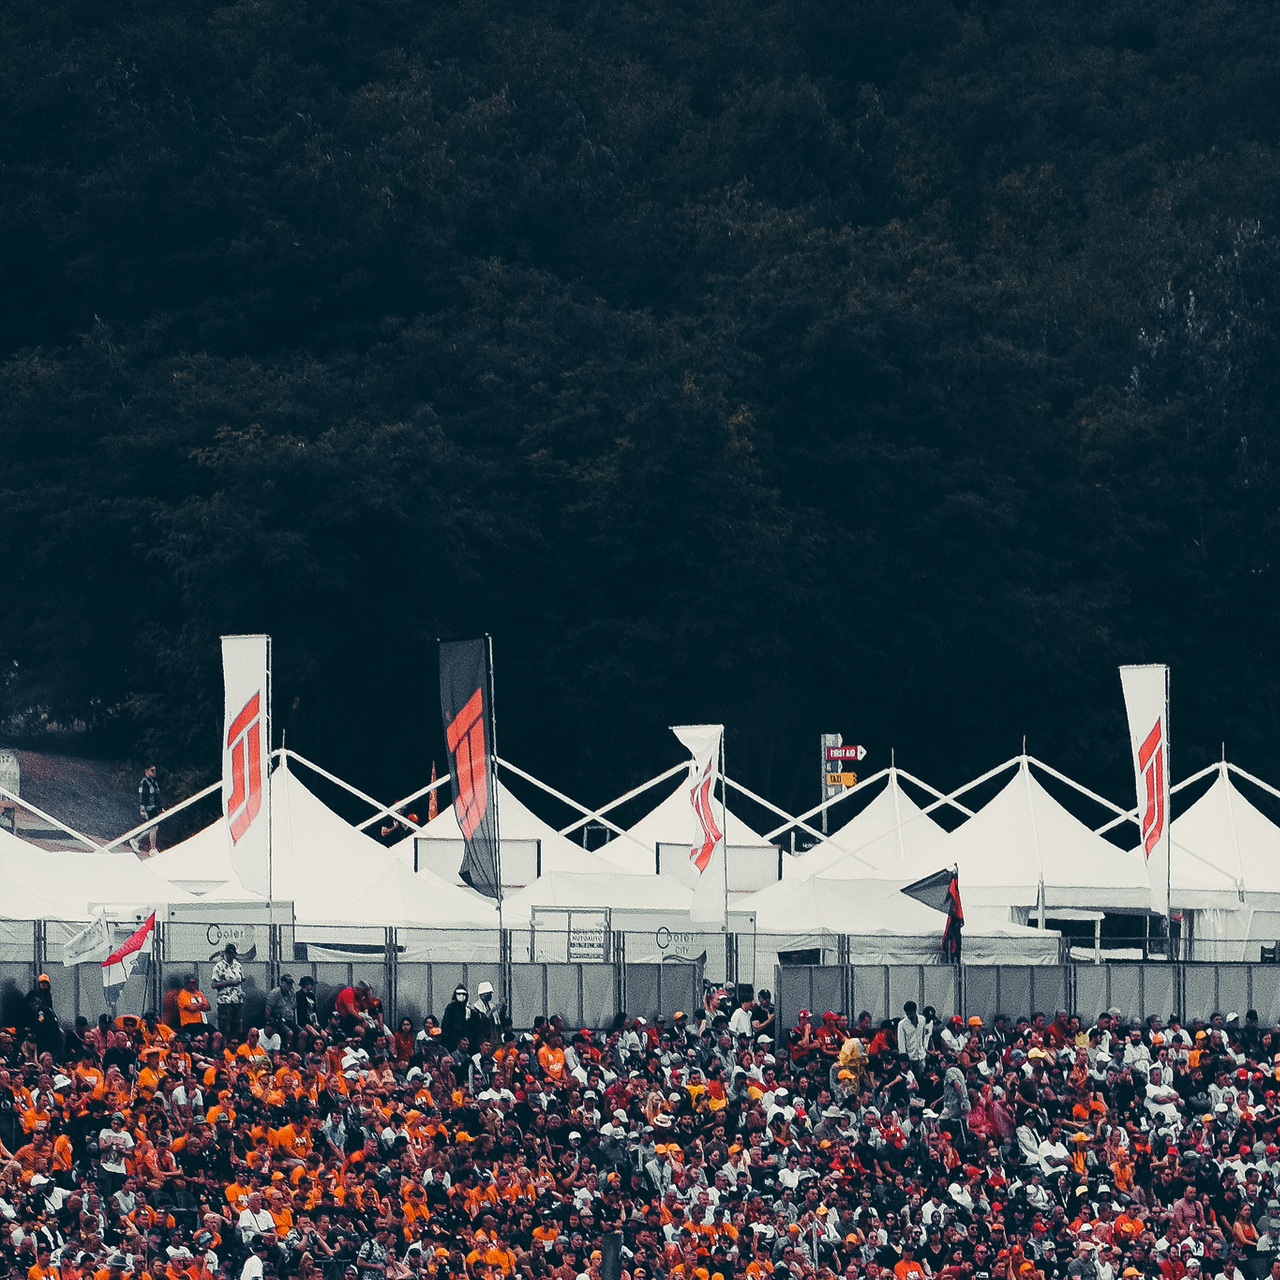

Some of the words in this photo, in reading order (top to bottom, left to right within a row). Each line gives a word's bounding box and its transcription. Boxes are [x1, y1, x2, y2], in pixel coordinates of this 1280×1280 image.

[830, 749, 845, 758] FIRST
[846, 748, 856, 757] AID
[206, 924, 244, 945] Cooler
